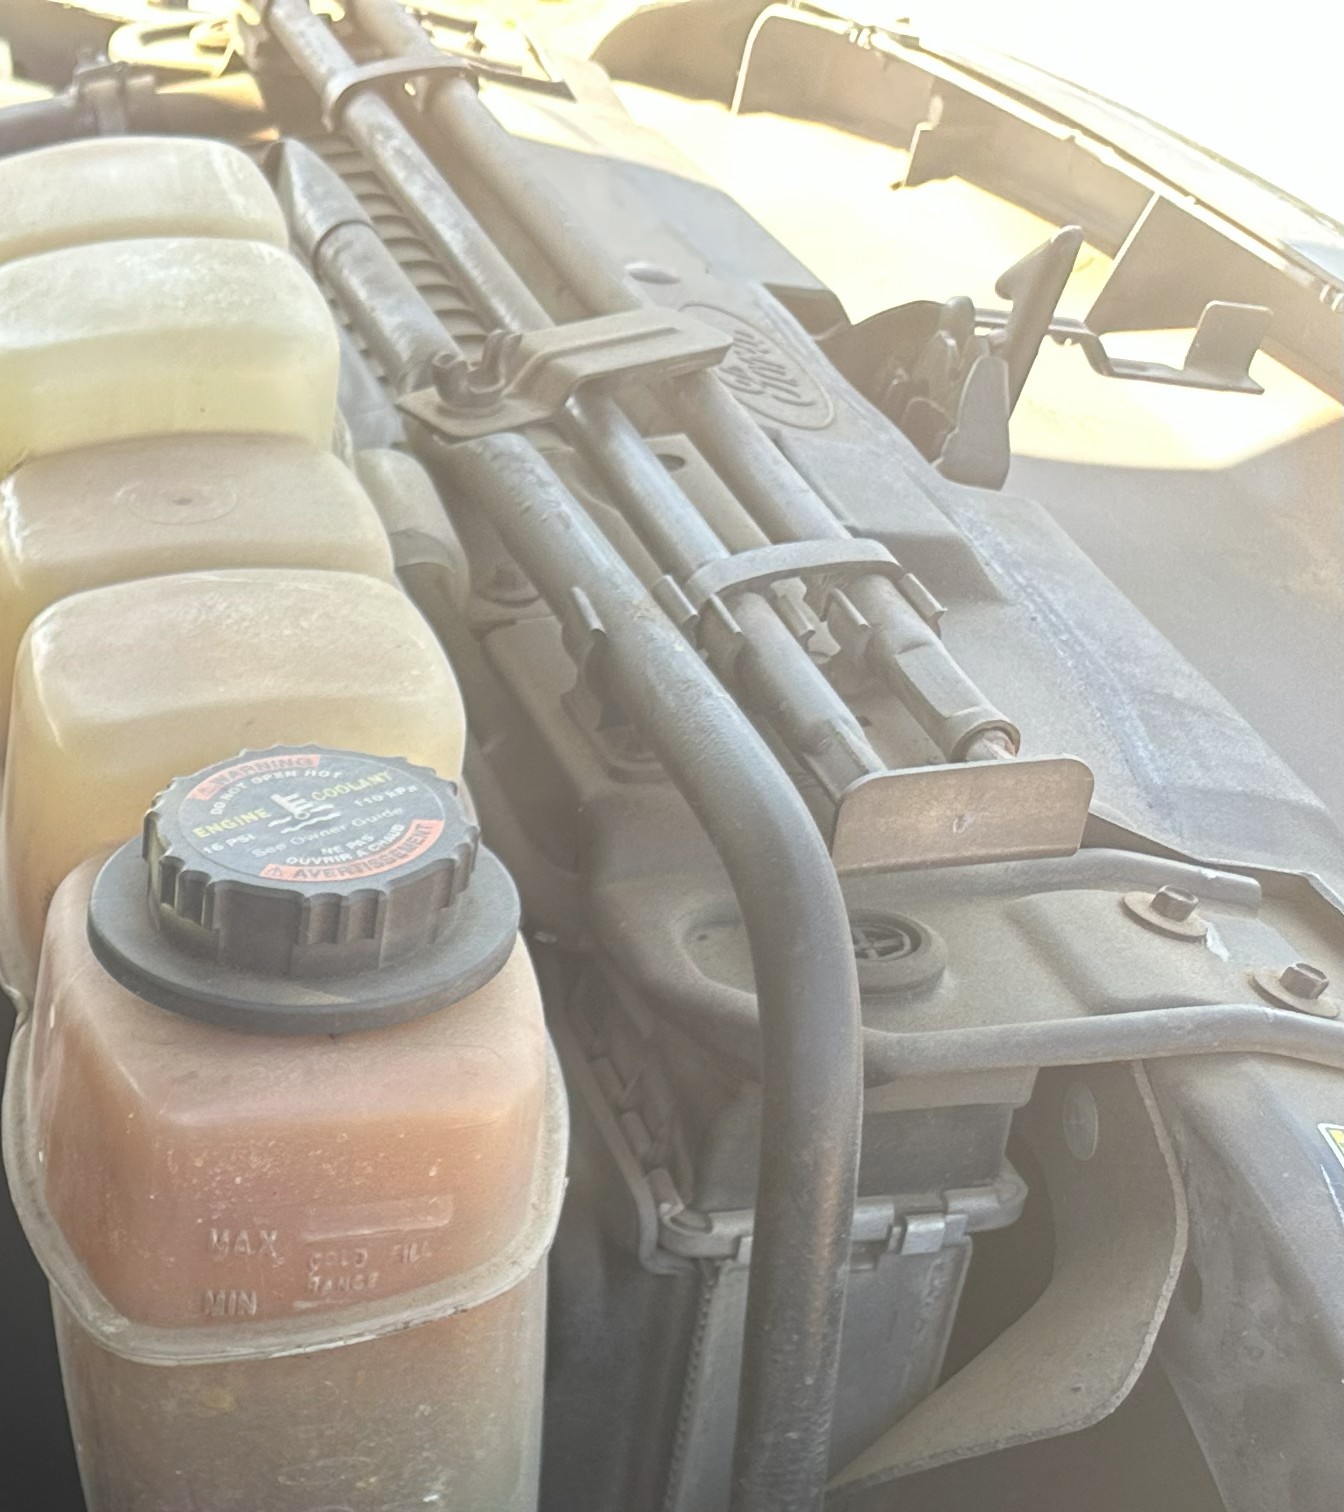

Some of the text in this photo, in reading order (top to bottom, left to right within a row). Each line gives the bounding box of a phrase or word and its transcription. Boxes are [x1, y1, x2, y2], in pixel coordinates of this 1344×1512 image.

[209, 756, 311, 792] WARNING
[221, 781, 247, 802] NOT
[252, 769, 297, 786] OPEN
[304, 769, 343, 780] HOT
[192, 771, 394, 839] ENGINE COOLANT
[226, 833, 256, 849] PSI
[251, 806, 405, 858] See Owner Guide
[292, 822, 435, 879] AVERTISSEMENT
[210, 1228, 278, 1259] MAX
[204, 1289, 258, 1316] MIN
